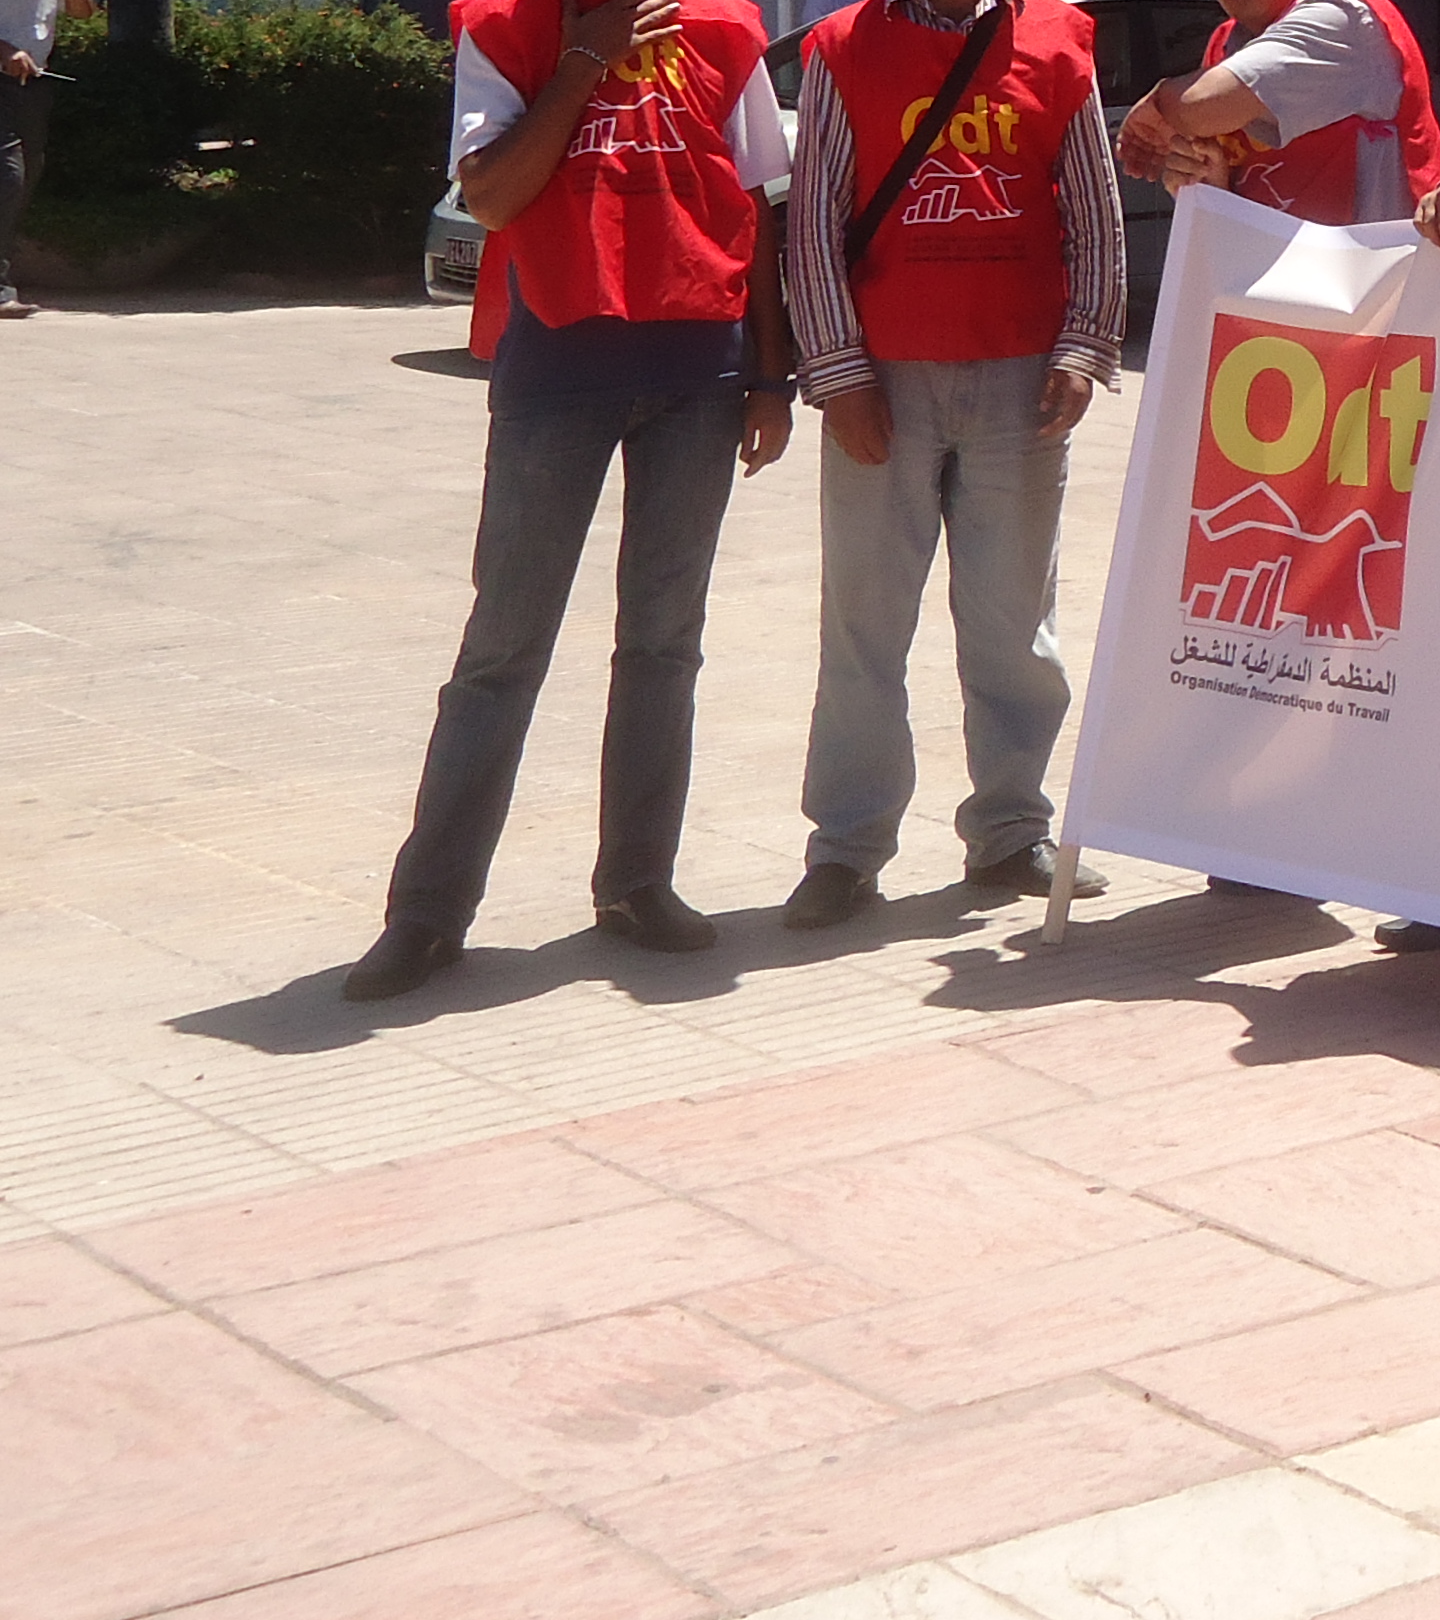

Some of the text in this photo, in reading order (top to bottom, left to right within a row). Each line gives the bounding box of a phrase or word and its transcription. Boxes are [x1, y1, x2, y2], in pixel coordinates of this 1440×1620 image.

[1169, 634, 1239, 669] للشغل
[1169, 669, 1250, 698] Organisation
[1325, 699, 1345, 716] du
[1346, 701, 1392, 724] Travail
[1318, 655, 1397, 698] المنظمة
